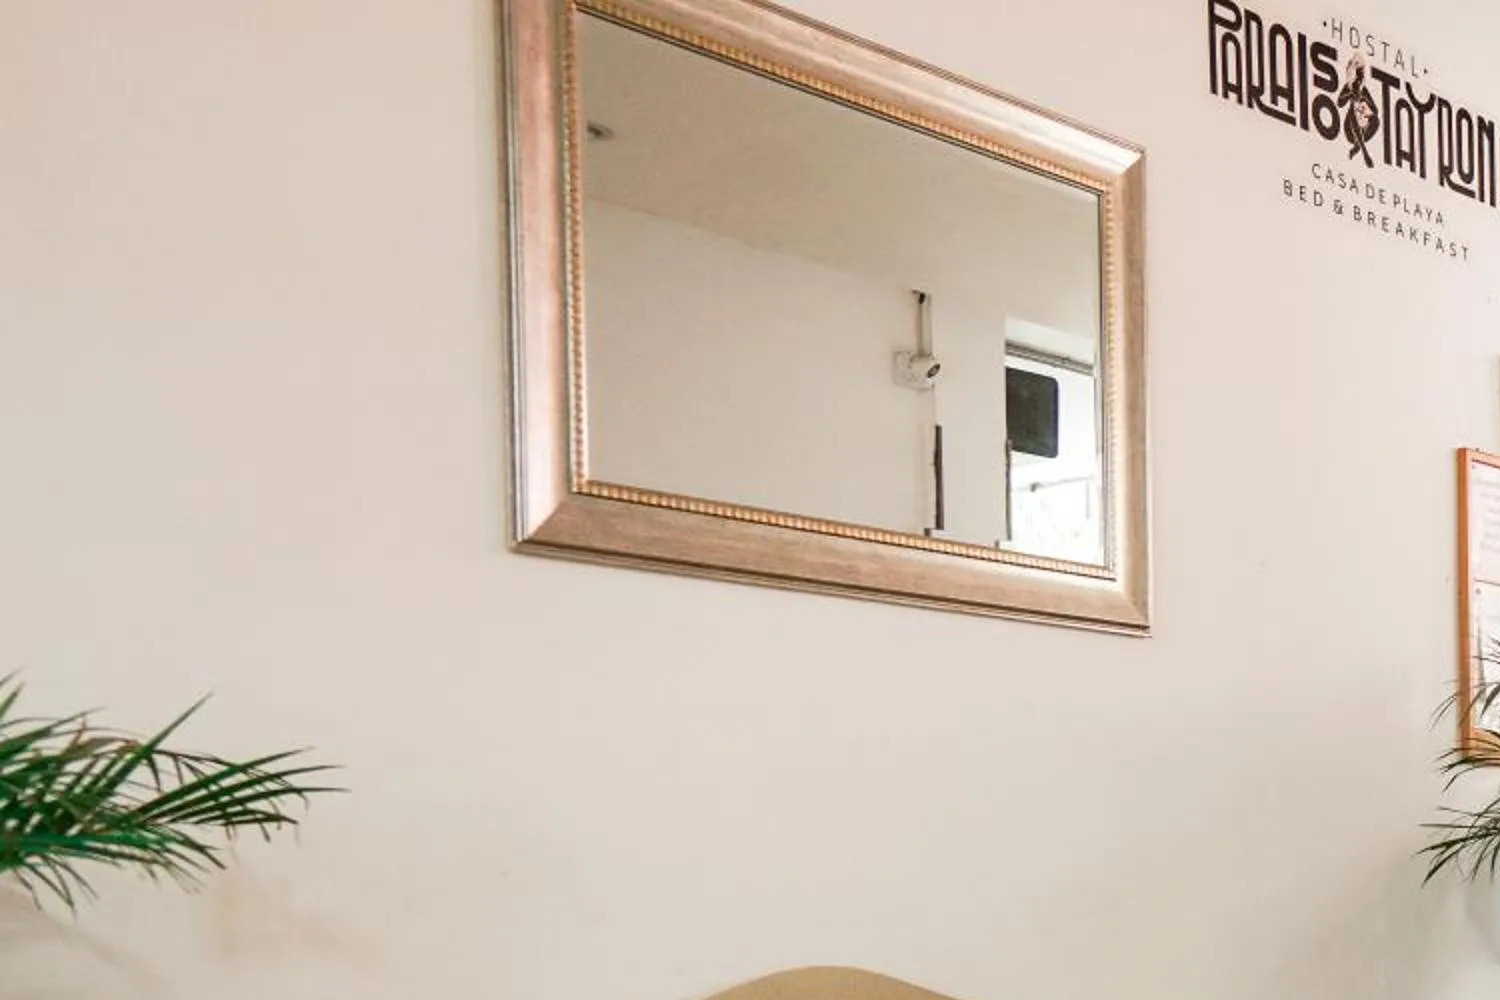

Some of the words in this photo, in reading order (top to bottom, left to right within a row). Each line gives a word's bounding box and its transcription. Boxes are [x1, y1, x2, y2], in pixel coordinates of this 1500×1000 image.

[1207, 0, 1342, 141] PARAISO
[1331, 18, 1420, 79] HOSTAL
[1283, 179, 1324, 207] BED
[1333, 200, 1345, 215] &
[1353, 205, 1470, 261] BREAKFAST
[1311, 163, 1359, 194] CASA
[1366, 182, 1386, 205] DE
[1393, 197, 1444, 226] PLAYA
